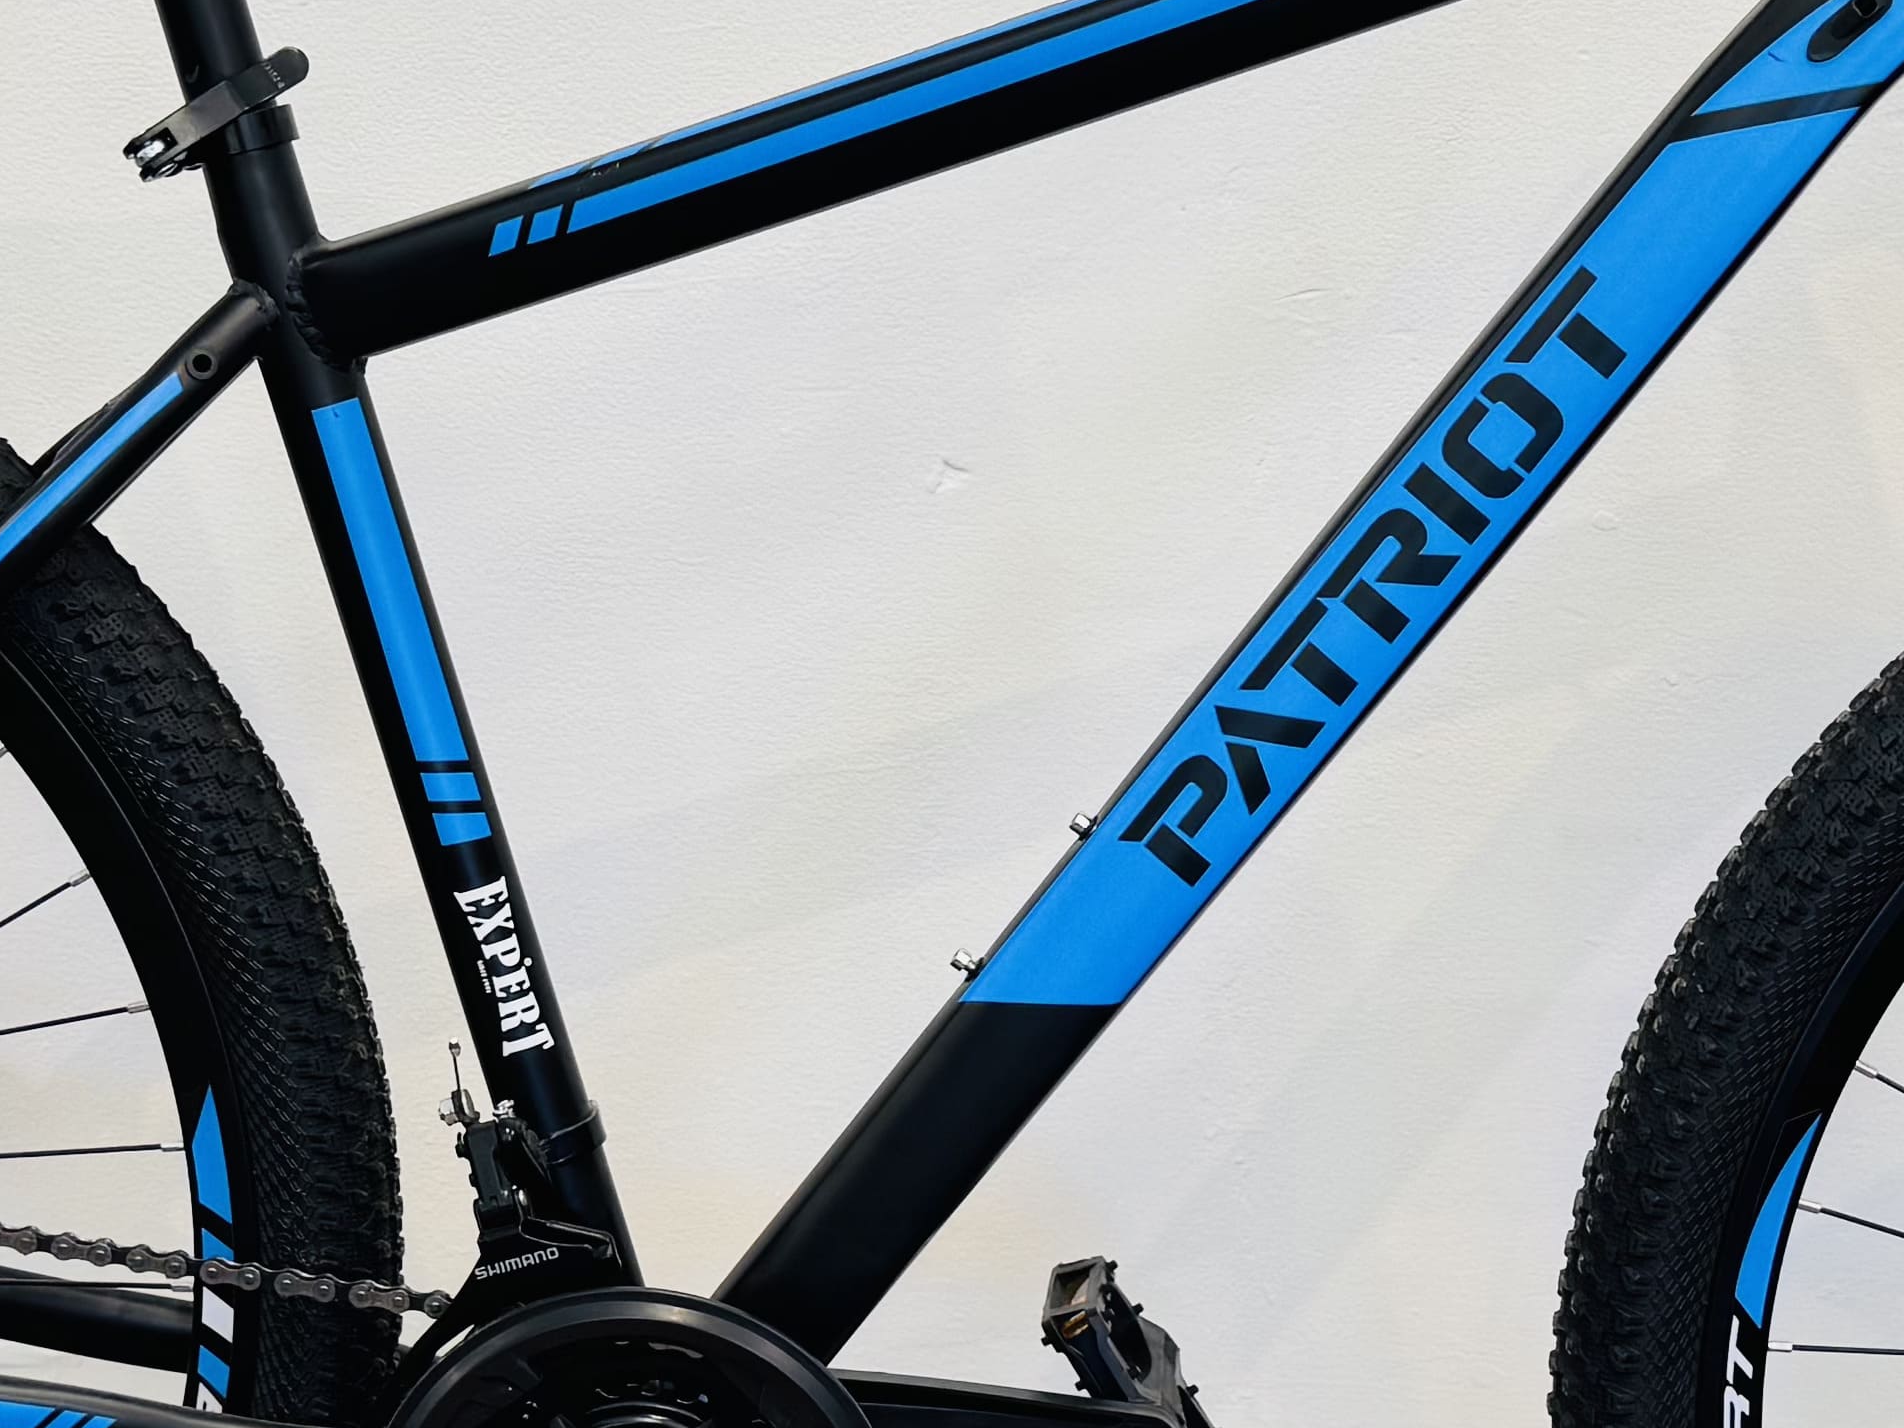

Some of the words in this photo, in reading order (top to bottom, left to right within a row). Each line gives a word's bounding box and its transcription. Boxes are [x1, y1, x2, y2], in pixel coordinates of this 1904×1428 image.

[1117, 265, 1628, 888] PATRIOT
[453, 875, 555, 1058] EXPERT
[475, 1246, 560, 1281] SHIMANO
